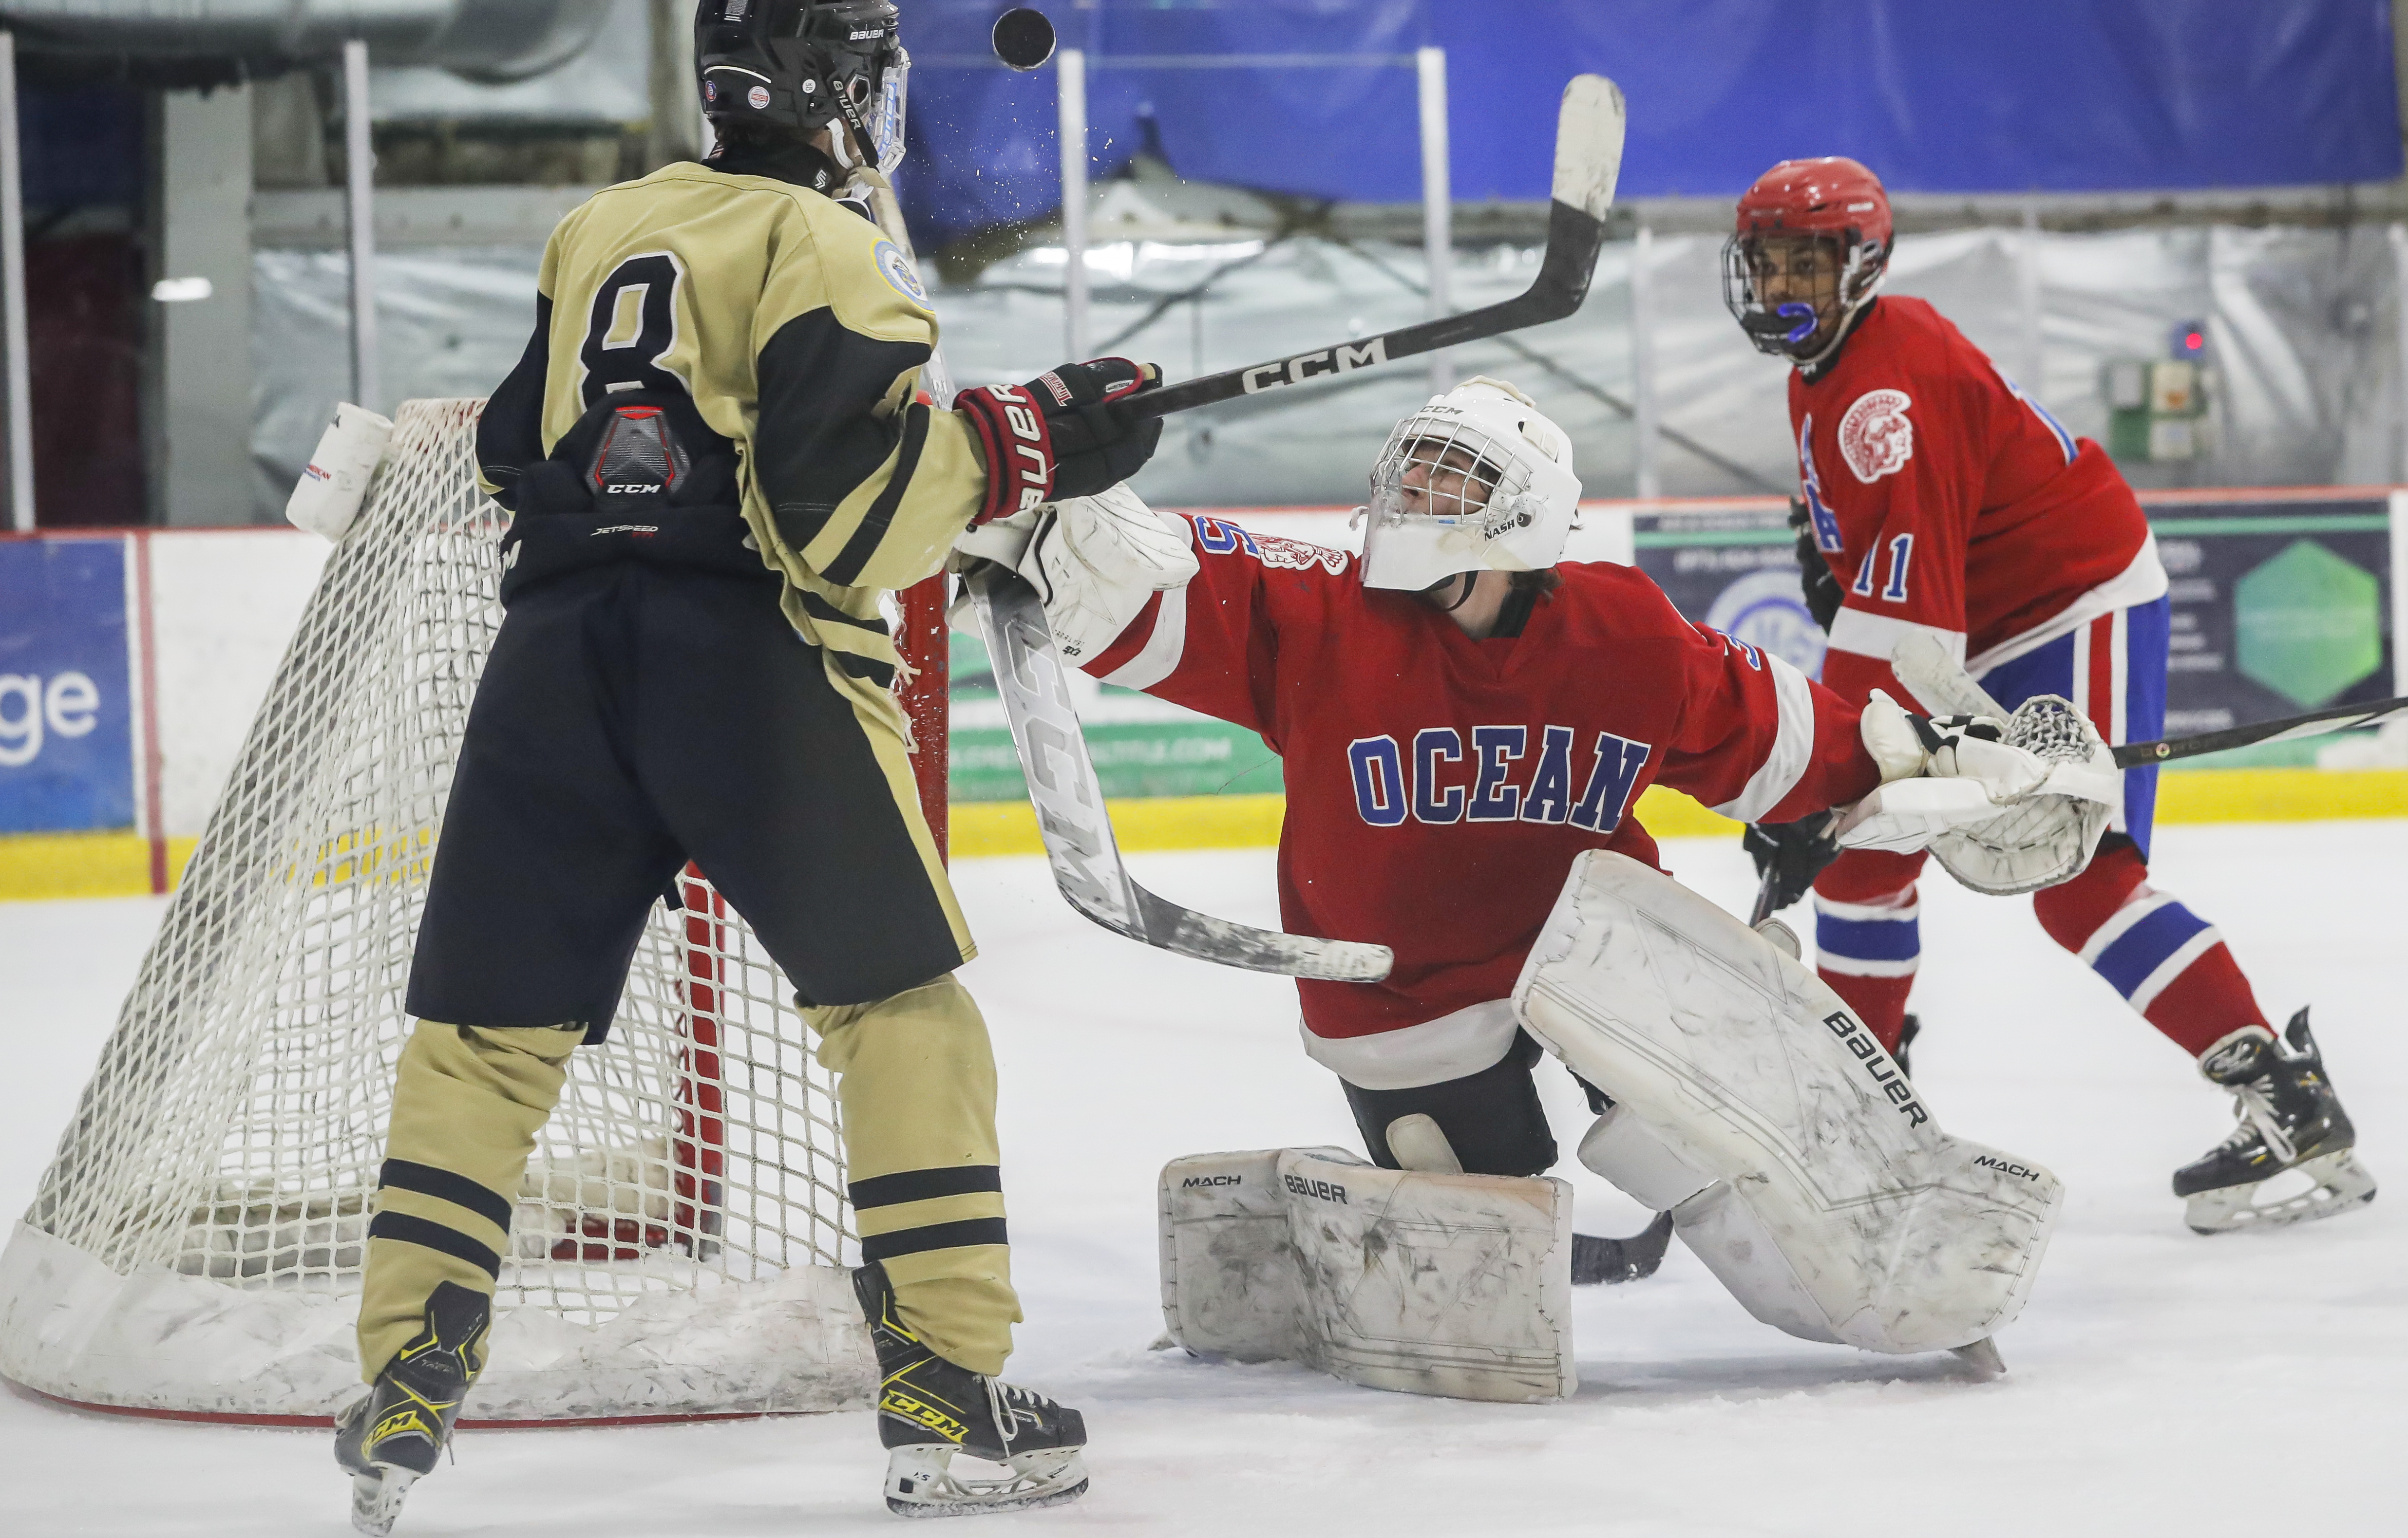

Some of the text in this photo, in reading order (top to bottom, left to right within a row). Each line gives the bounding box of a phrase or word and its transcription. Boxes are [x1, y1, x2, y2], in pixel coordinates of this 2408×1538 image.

[850, 29, 885, 40] BAUER
[577, 250, 687, 415] 8
[1243, 336, 1387, 394] CCM
[1419, 406, 1464, 415] CCM
[607, 485, 662, 494] CCM
[590, 525, 659, 537] JETSPEED
[1484, 519, 1515, 542] NASH
[1852, 531, 1915, 604] 11
[1347, 724, 1652, 834] OCEAN
[1822, 1011, 1929, 1129] BAUER
[1182, 1175, 1242, 1188] MACH
[1973, 1155, 2040, 1182] MACH
[1284, 1174, 1348, 1205] BAUER
